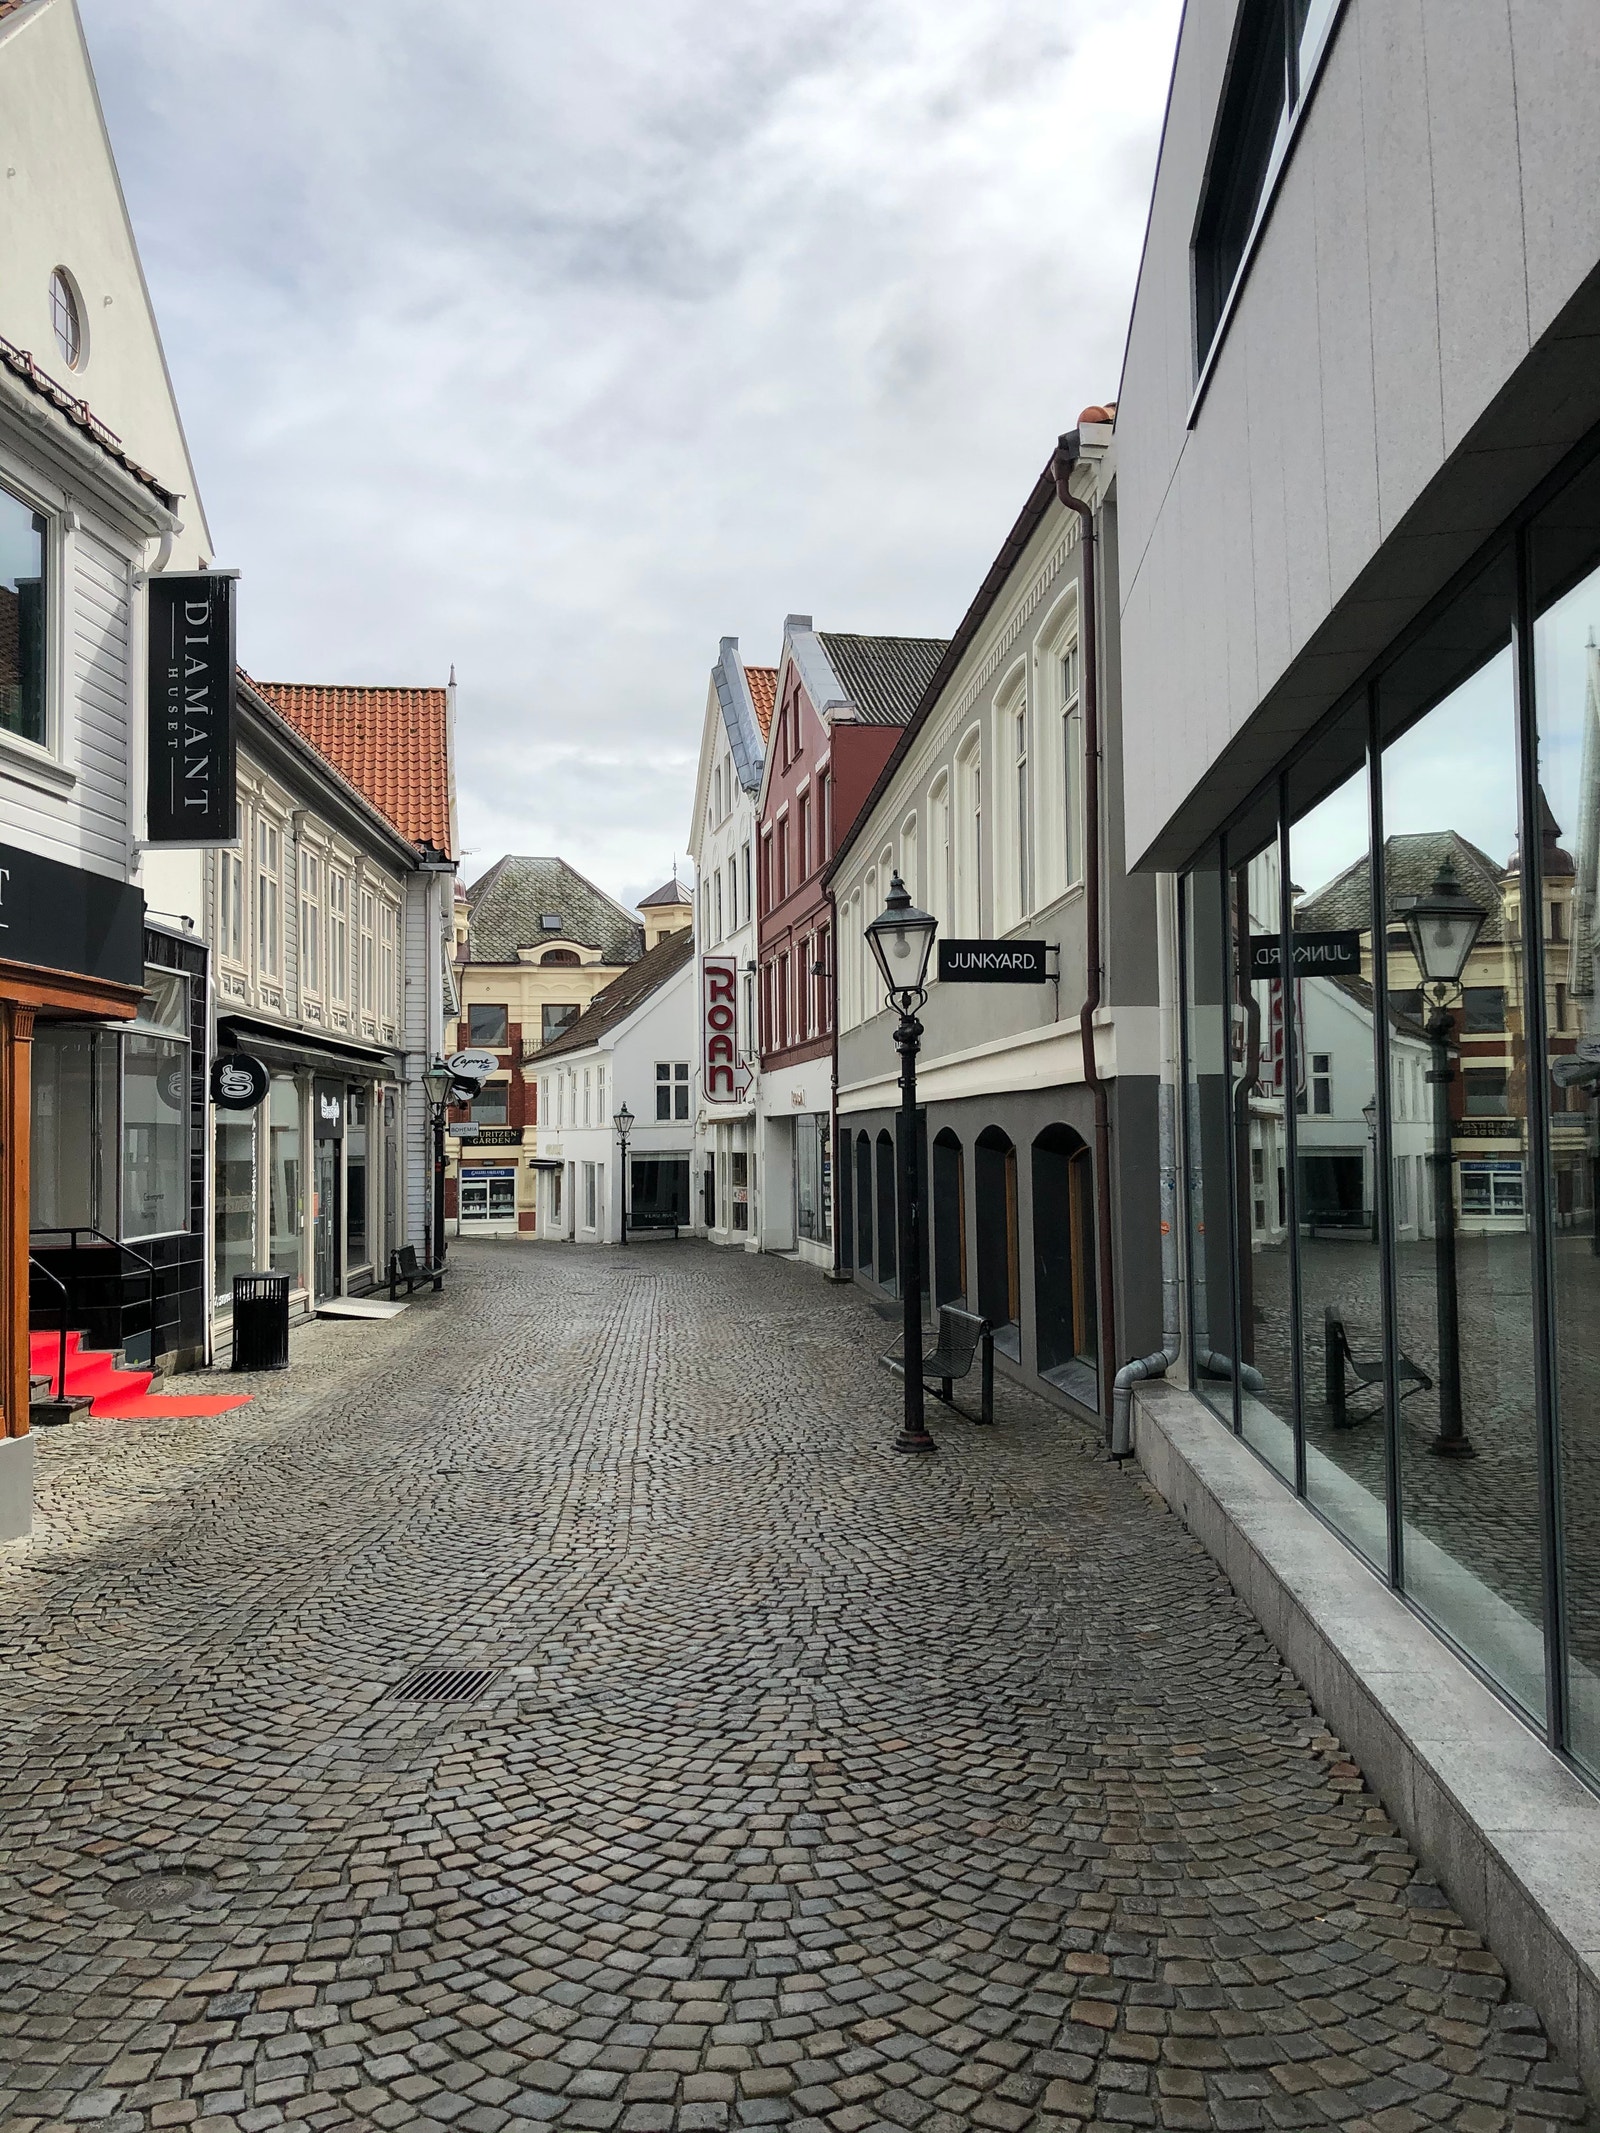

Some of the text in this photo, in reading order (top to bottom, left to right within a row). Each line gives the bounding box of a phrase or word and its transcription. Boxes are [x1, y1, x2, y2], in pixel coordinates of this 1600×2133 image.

[168, 667, 179, 749] HUSET
[184, 600, 209, 815] DIAMANT
[948, 952, 1037, 970] JUNKYARD.
[451, 1055, 494, 1068] Capone
